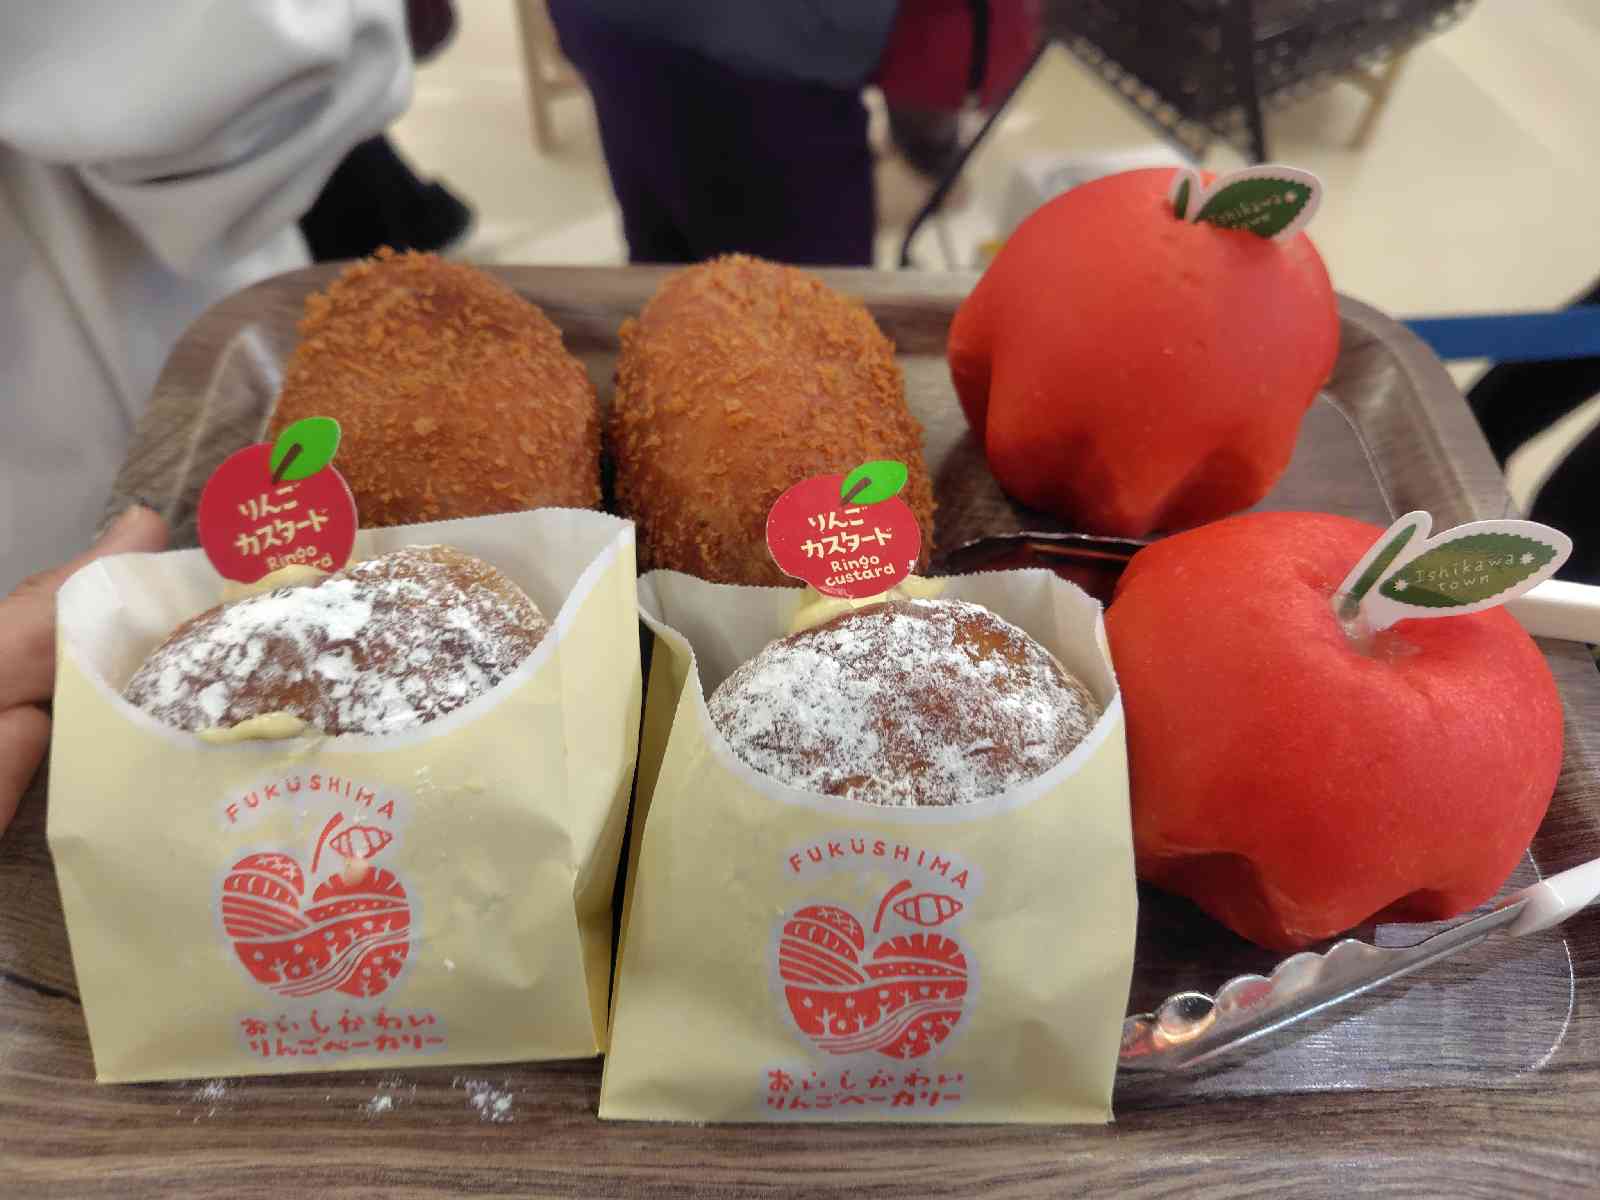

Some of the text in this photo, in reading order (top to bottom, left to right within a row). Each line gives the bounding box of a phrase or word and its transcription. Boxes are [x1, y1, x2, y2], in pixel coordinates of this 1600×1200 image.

[237, 482, 301, 521] りんご
[234, 507, 329, 556] カスタード
[807, 506, 868, 532] りんご
[801, 527, 893, 559] カスタード
[824, 562, 896, 587] custard
[830, 554, 881, 574] Ringo
[1414, 553, 1515, 584] Ishikawa
[1437, 574, 1490, 592] town
[225, 774, 396, 824] FUKUSHIMA
[788, 838, 970, 890] FUKUSHIMA
